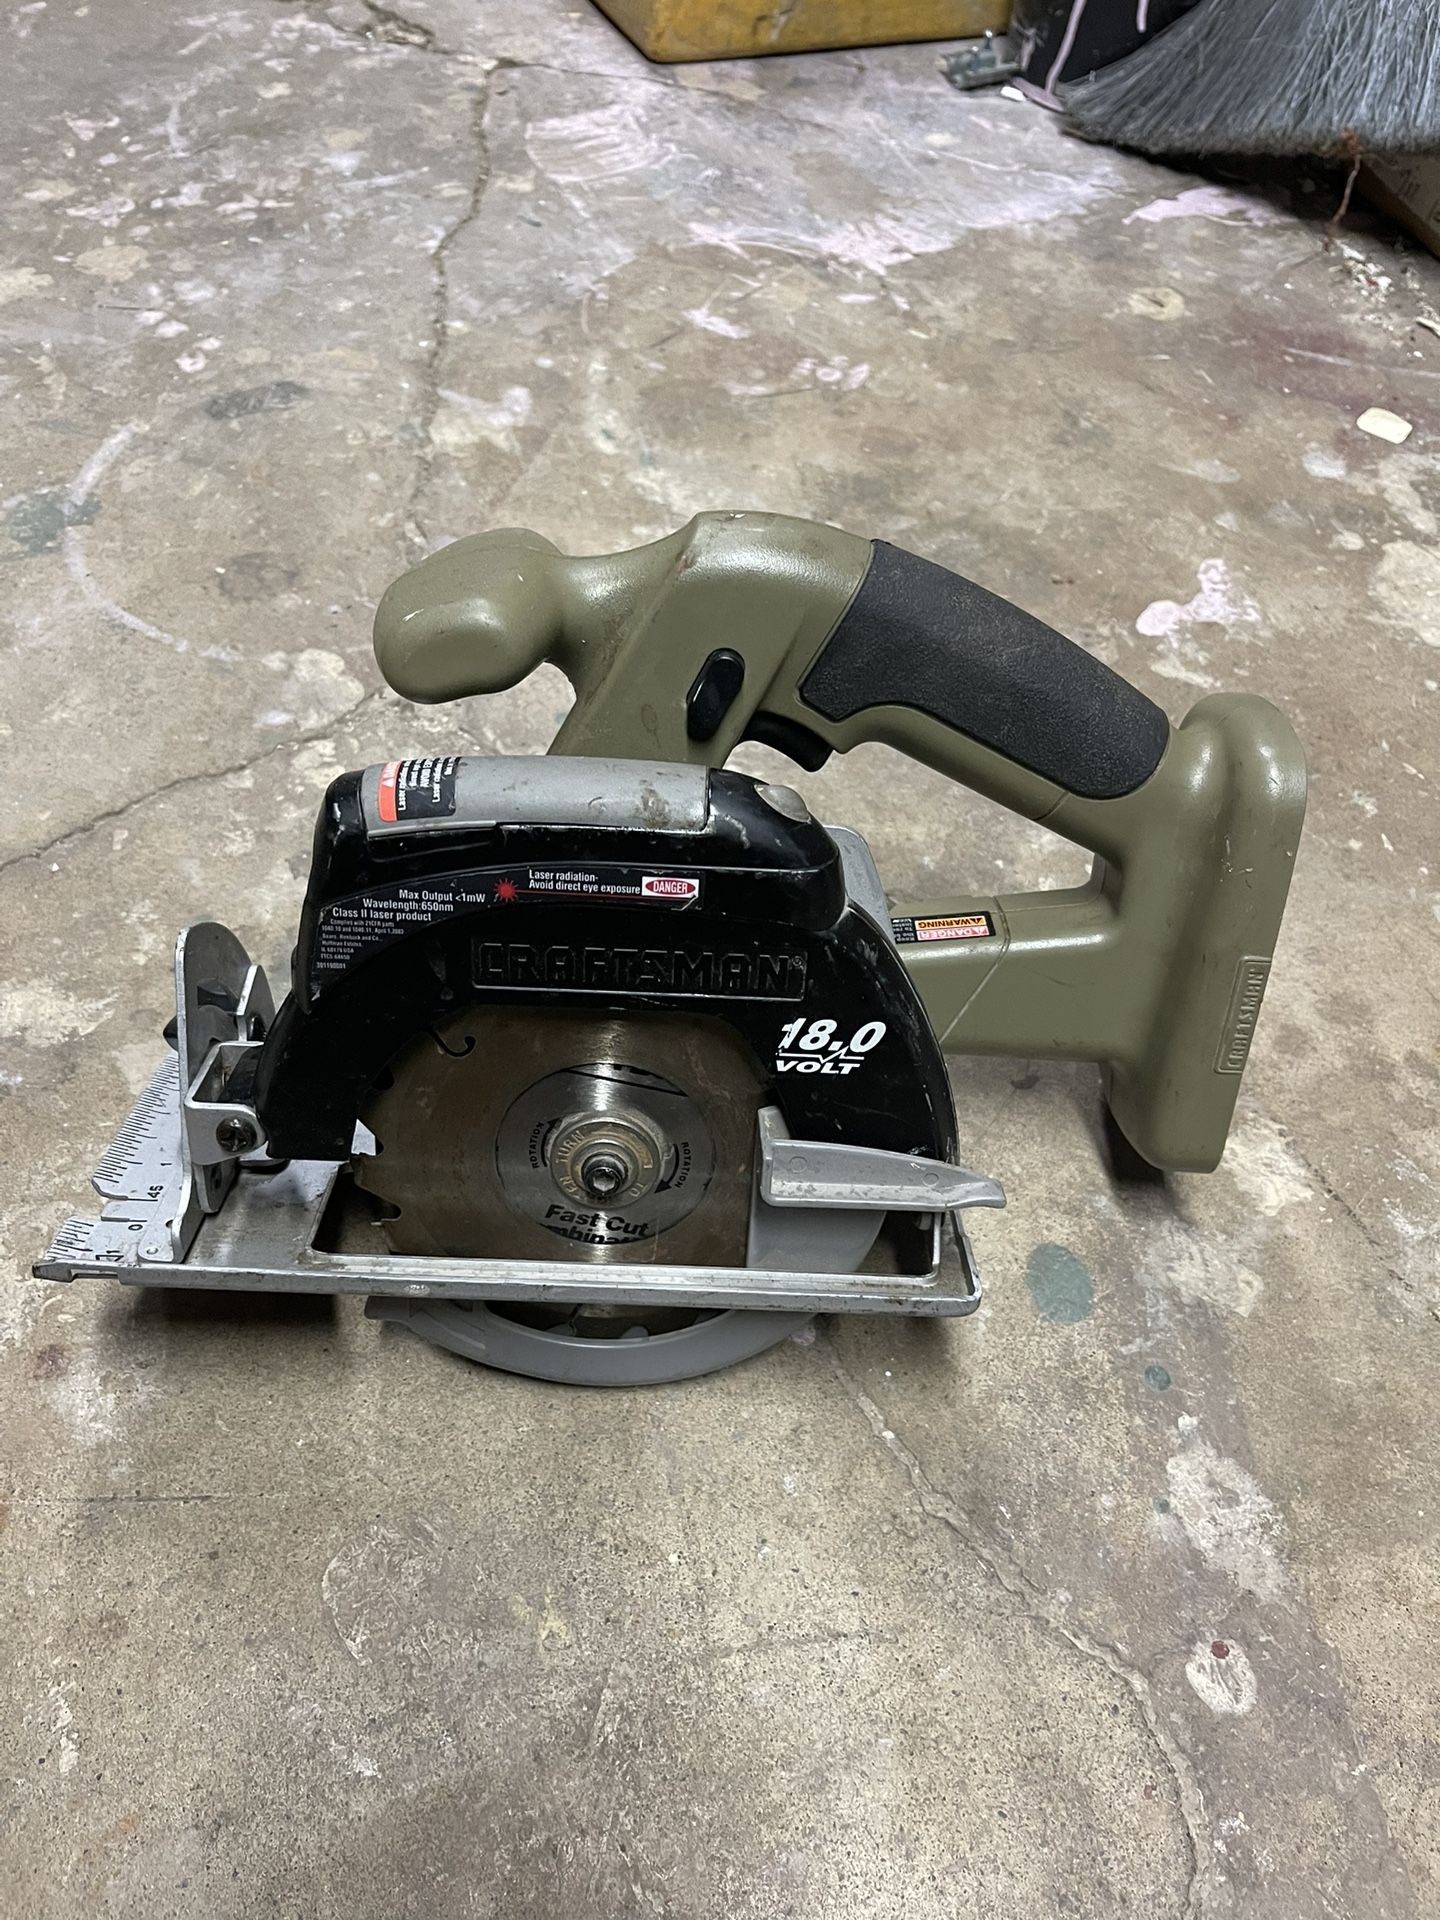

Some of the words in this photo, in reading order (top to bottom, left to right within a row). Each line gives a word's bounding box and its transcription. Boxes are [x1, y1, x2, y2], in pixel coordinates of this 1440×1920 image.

[420, 769, 431, 788] AVOID
[398, 790, 406, 811] Laser
[432, 783, 440, 803] Laser
[529, 869, 554, 880] Laser
[529, 879, 554, 890] Avoid
[555, 881, 581, 892] direct
[582, 883, 599, 893] eye
[600, 885, 641, 895] exposure
[653, 880, 688, 893] DANGER
[399, 889, 419, 900] Max
[421, 890, 453, 902] Output
[455, 892, 486, 903] <1mW
[362, 898, 454, 912] Wavelength:650nm
[332, 907, 359, 918] Class
[370, 909, 394, 919] laser
[396, 911, 432, 922] product
[918, 918, 971, 929] WARNING
[919, 928, 971, 939] DANGER
[479, 943, 790, 990] CRAFTSMAN
[1227, 971, 1264, 1067] CRAFTSMAN
[778, 1017, 887, 1053] 18.0
[776, 1060, 861, 1075] VOLT
[528, 1122, 545, 1169] ROTATION
[555, 1129, 585, 1163] TURN
[674, 1141, 692, 1188] ROTATION
[147, 1185, 164, 1198] 45
[545, 1203, 600, 1227] Fast
[606, 1215, 649, 1236] Cut
